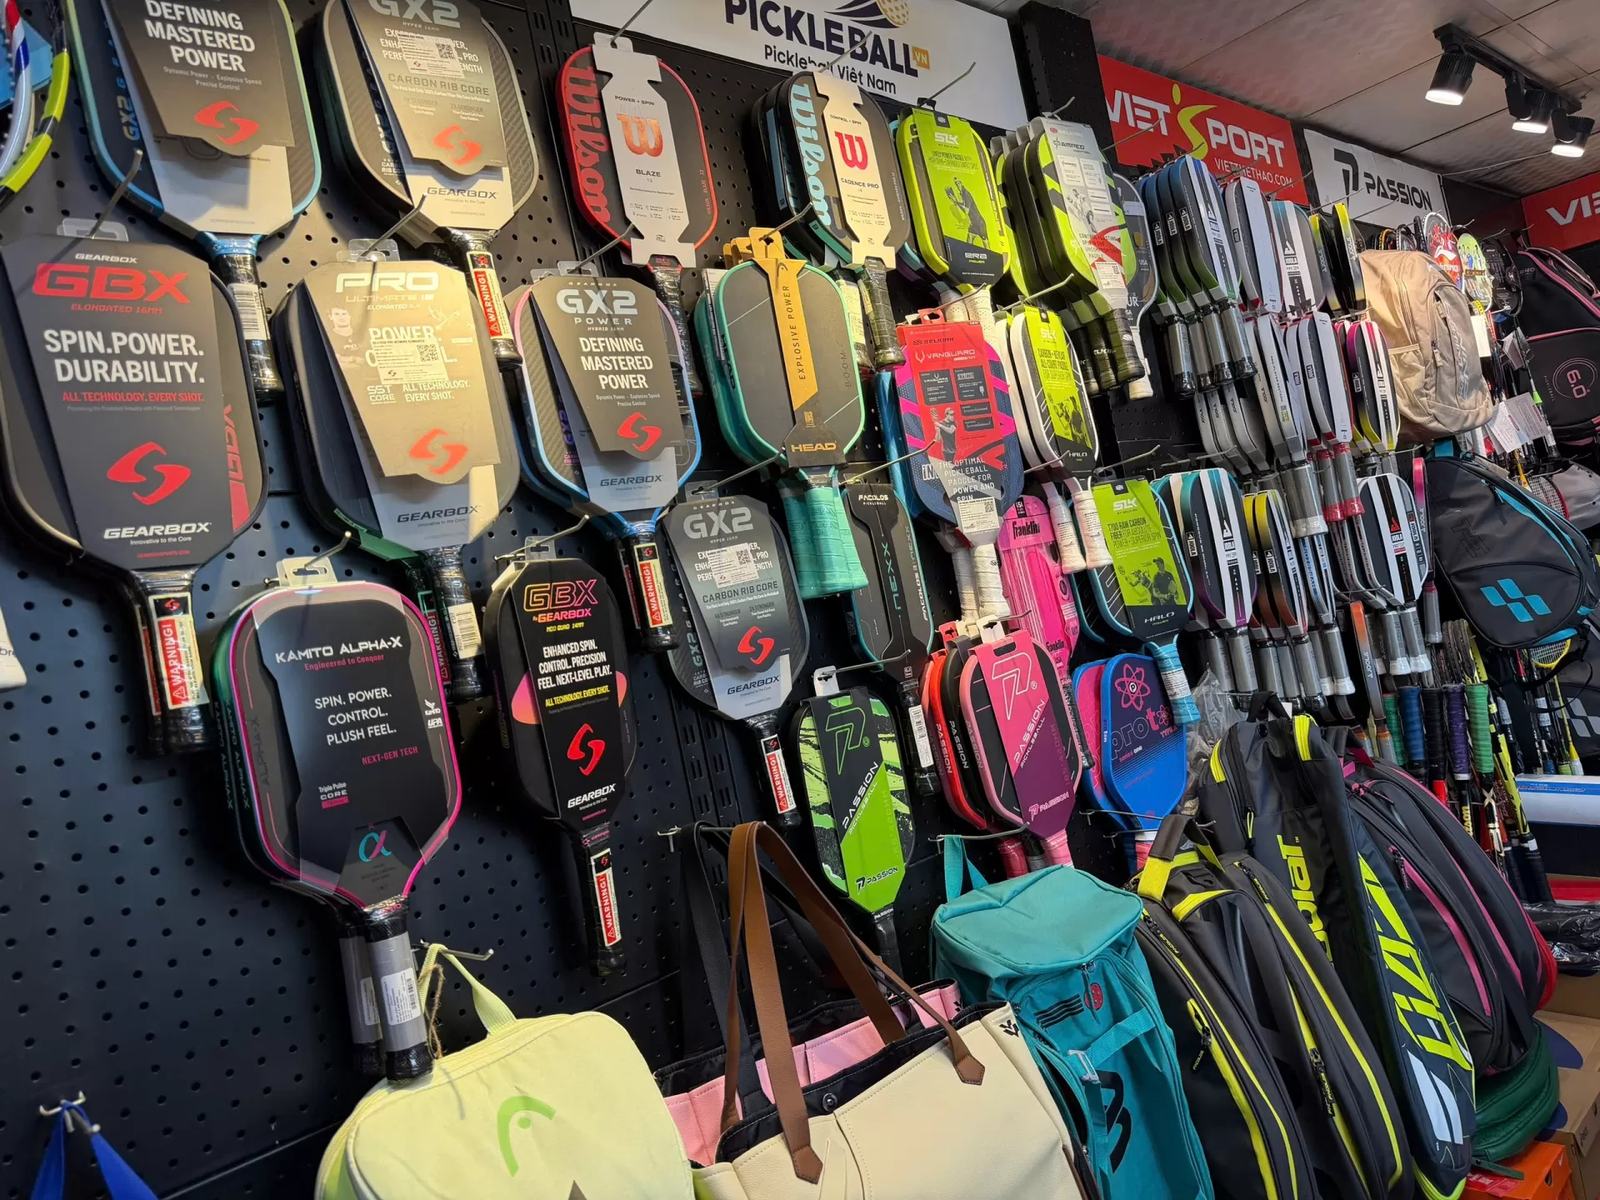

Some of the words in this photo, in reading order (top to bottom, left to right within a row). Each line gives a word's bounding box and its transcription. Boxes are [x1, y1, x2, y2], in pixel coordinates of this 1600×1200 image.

[145, 0, 243, 31] DEFINING
[369, 0, 460, 29] GX2
[144, 20, 256, 53] MASTERED
[724, 0, 918, 77] PICKLEBALL
[170, 44, 246, 73] POWER
[462, 52, 480, 63] PRO
[388, 73, 438, 88] CARBON
[440, 80, 459, 91] RIB
[461, 83, 489, 96] CORE
[866, 73, 897, 94] Nam
[1106, 90, 1171, 136] VIET
[1177, 104, 1285, 168] SPORT
[566, 65, 611, 224] Wilson
[790, 82, 832, 226] Wilson
[635, 168, 662, 178] BLAZE
[841, 177, 866, 188] CADENCE
[866, 181, 880, 189] PRO
[426, 187, 498, 200] GEARBOX
[1363, 172, 1432, 211] PASSION
[75, 252, 138, 264] GEARBOX
[32, 262, 191, 304] GBX
[335, 271, 440, 294] PRO
[71, 303, 133, 313] ELONGATED
[475, 271, 495, 323] WARNING!
[556, 288, 638, 315] GX2
[782, 285, 797, 320] POWER
[574, 317, 632, 325] POWER
[43, 328, 205, 357] SPIN.POWER.
[368, 325, 435, 342] POWER
[579, 336, 644, 352] DEFINING
[580, 355, 654, 371] MASTERED
[789, 324, 806, 381] EXPLOSIVE
[926, 348, 976, 359] VANGUARD
[54, 358, 206, 384] DURABILITY.
[598, 374, 649, 389] POWER
[63, 391, 81, 402] ALL
[149, 392, 177, 402] EVERY
[366, 384, 392, 395] SST
[402, 381, 419, 392] ALL
[405, 391, 431, 402] EVERY
[431, 389, 456, 401] SHOT.
[790, 442, 837, 453] HEAD
[600, 474, 662, 487] GEARBOX
[944, 464, 989, 477] PICKLEBALL
[977, 473, 992, 481] FOR
[953, 485, 980, 494] POWER
[980, 482, 995, 490] AND
[396, 505, 479, 523] GEARBOX
[1113, 498, 1138, 512] SLK
[103, 521, 213, 540] GEARBOX
[683, 505, 754, 540] GX2
[1012, 520, 1041, 539] Franklin
[756, 551, 769, 560] PRO
[523, 579, 599, 612] GBX
[642, 566, 658, 611] WARNING!
[702, 588, 739, 604] CARBON
[740, 585, 755, 596] RIB
[756, 580, 779, 593] CORE
[537, 608, 592, 623] GEARBOX
[1144, 611, 1176, 623] HALO
[163, 623, 184, 689] WARNING!
[275, 645, 334, 664] KAMITO
[340, 636, 403, 656] ALPHA-X
[543, 641, 580, 658] ENHANCED
[580, 639, 598, 652] SPIN.
[304, 658, 346, 673] Engineered
[347, 658, 355, 666] to
[539, 658, 572, 674] CONTROL.
[571, 651, 607, 668] PRECISION
[537, 676, 556, 690] FEEL.
[555, 670, 594, 687] NEXT-LEVEL
[593, 665, 613, 680] PLAY.
[727, 675, 780, 696] GEARBOX
[314, 694, 347, 710] SPIN.
[348, 687, 392, 704] POWER.
[545, 697, 555, 707] ALL
[582, 688, 597, 699] EVERY
[596, 685, 611, 696] SHOT.
[327, 705, 389, 727] CONTROL.
[326, 727, 365, 747] PLUSH
[367, 722, 397, 740] FEEL.
[1013, 699, 1046, 764] PASSION
[935, 722, 953, 775] PASSION
[949, 719, 969, 769] PASSION
[362, 749, 400, 766] NEXT-GEN
[400, 745, 419, 758] TECH
[770, 757, 784, 801] WARNING!
[320, 789, 348, 800] CORE
[566, 783, 617, 809] GEARBOX
[841, 761, 880, 829] PASSION
[866, 866, 899, 885] PASSION
[599, 877, 613, 929] WARNING!
